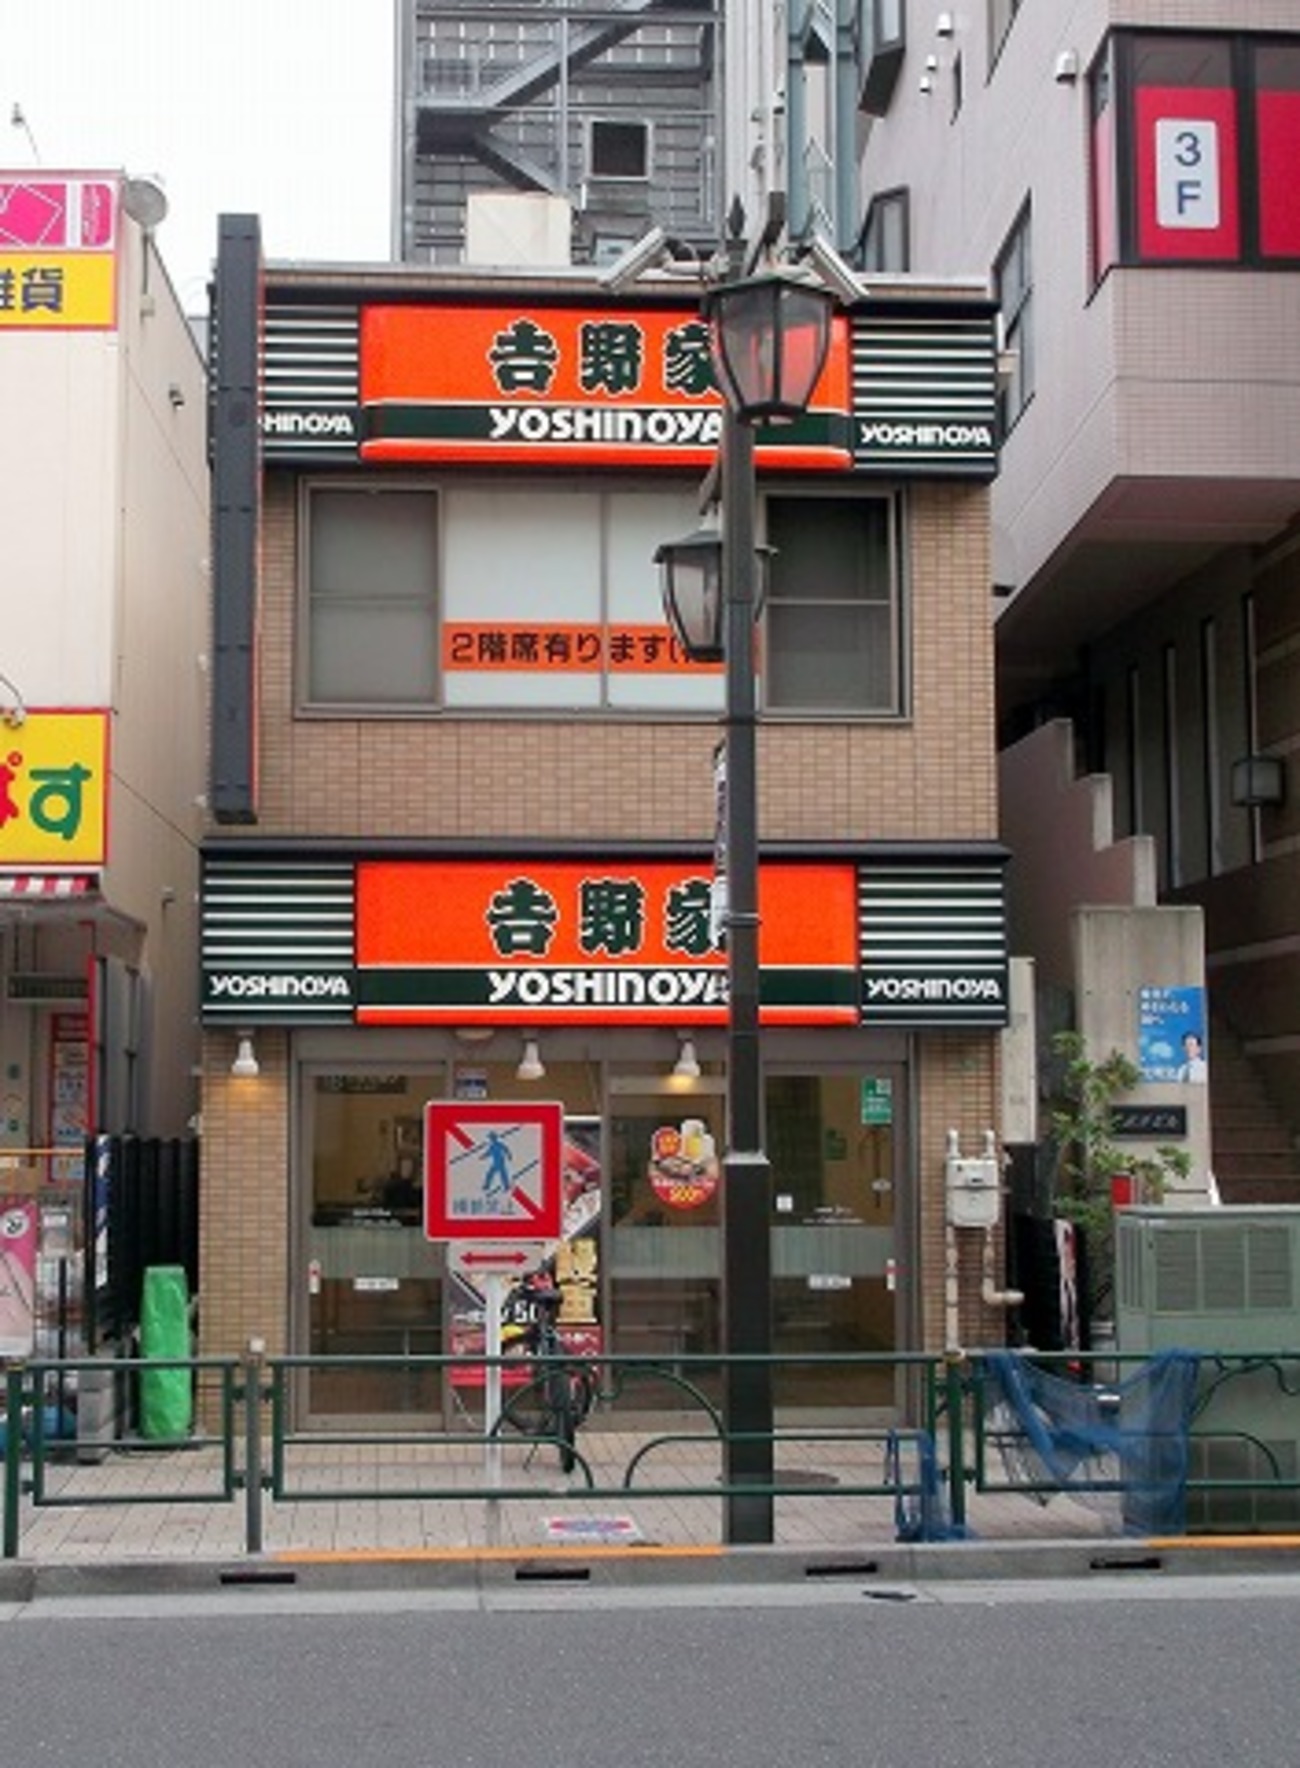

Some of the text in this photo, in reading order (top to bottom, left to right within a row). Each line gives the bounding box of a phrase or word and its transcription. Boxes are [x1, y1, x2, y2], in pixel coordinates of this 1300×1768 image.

[1174, 131, 1202, 215] 3F
[860, 423, 991, 446] YOSHINOYA
[209, 975, 350, 996] YOSHINOYA
[866, 977, 1001, 1000] YOSHINOYA
